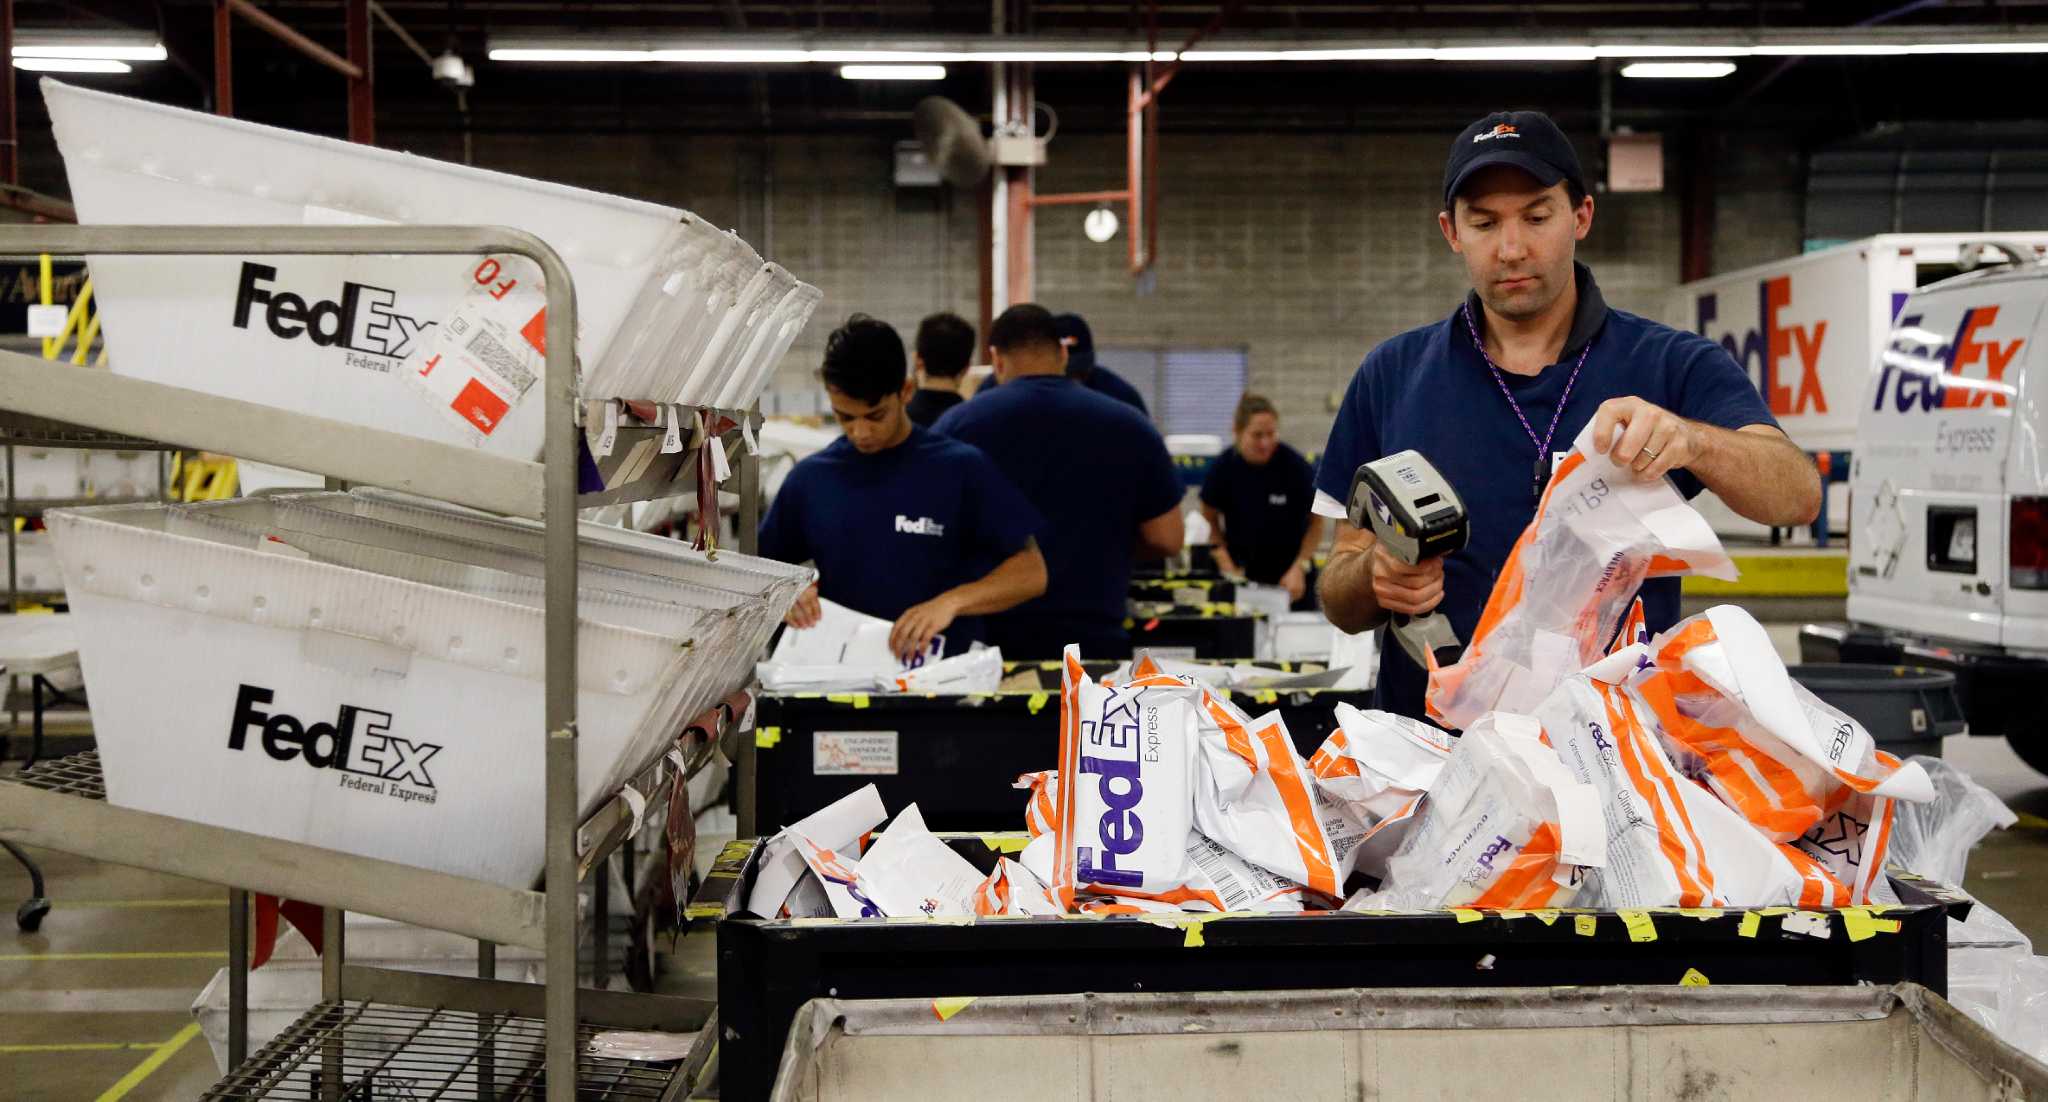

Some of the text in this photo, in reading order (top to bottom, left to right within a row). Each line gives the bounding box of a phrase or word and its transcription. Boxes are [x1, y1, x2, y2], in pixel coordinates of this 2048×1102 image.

[233, 261, 438, 359] FedEx
[345, 353, 390, 373] Federal
[1874, 305, 2025, 413] FedEx
[228, 683, 443, 789] FedEx
[1144, 705, 1160, 763] Express
[340, 774, 437, 805] Federal Express
[1077, 686, 1148, 887] FedEx
[1462, 834, 1513, 888] FedEx
